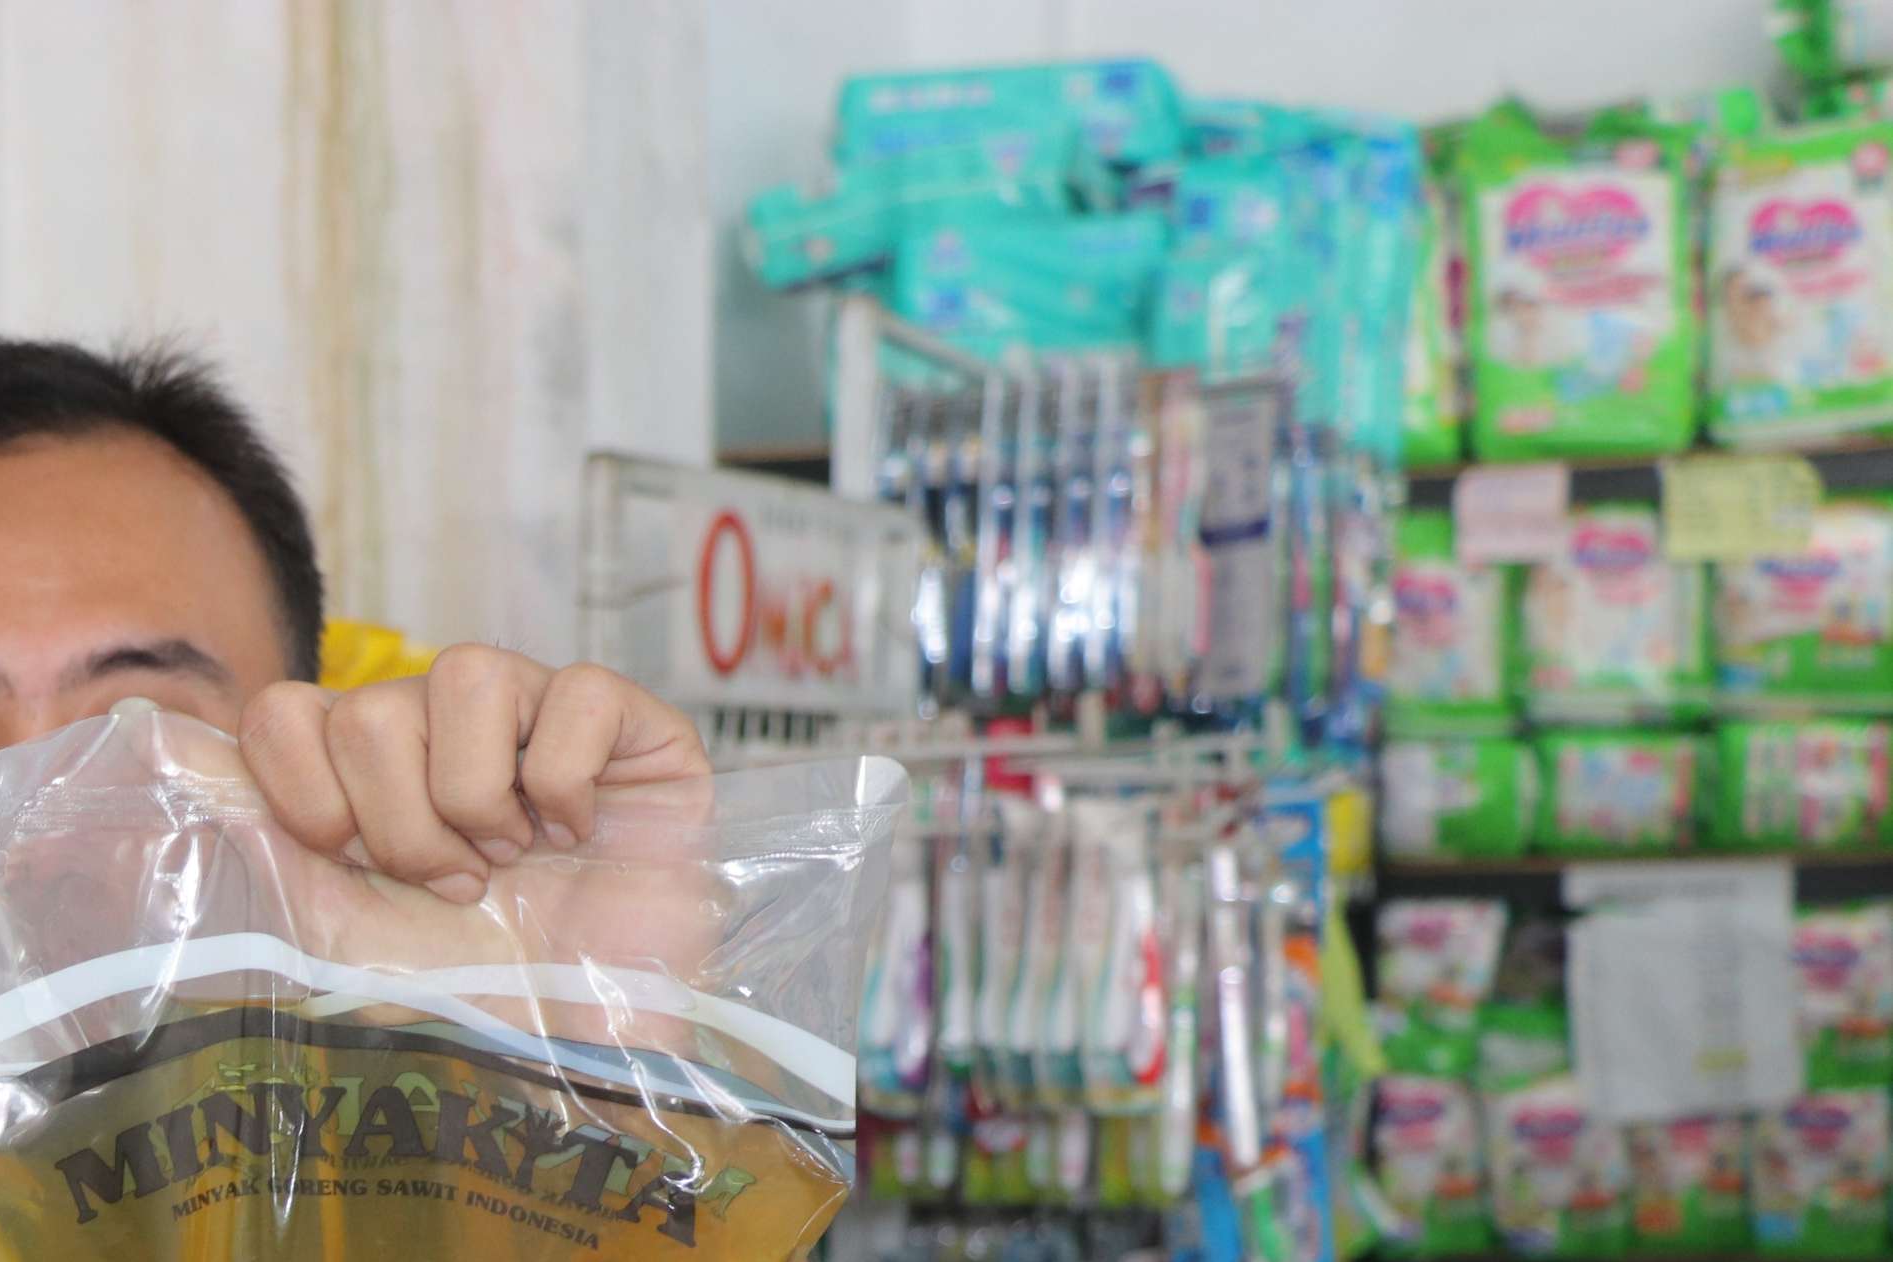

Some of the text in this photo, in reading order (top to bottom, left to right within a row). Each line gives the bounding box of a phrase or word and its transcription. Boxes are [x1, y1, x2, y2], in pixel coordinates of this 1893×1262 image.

[172, 1176, 602, 1251] MINYAK GORENG SAWIT INDONESIA
